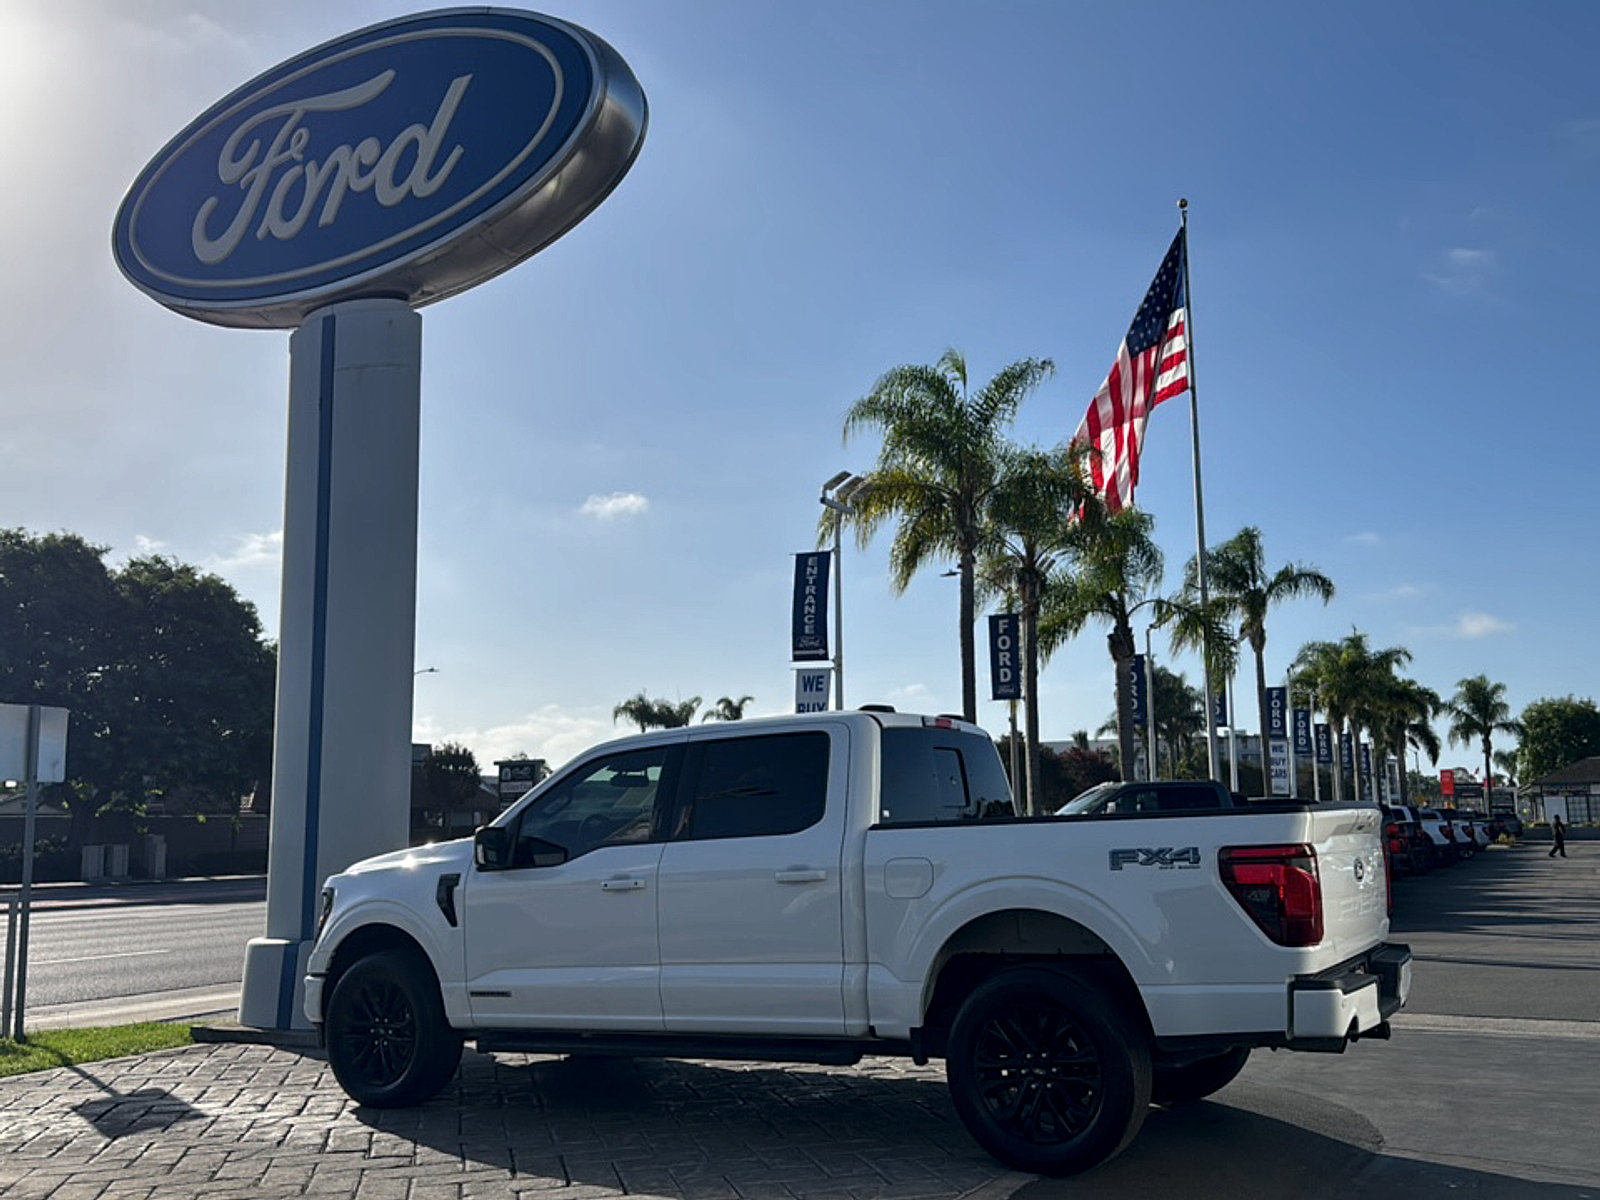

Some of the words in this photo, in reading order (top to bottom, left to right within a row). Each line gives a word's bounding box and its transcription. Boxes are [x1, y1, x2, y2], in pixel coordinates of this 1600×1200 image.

[192, 68, 473, 264] Ford
[803, 556, 818, 634] ENTRANCE
[997, 618, 1012, 683] FORD
[802, 675, 824, 692] WE
[1271, 690, 1281, 728] FORD
[1297, 711, 1307, 746] FORD
[1318, 726, 1328, 755] FORD
[1108, 847, 1200, 870] FX4
